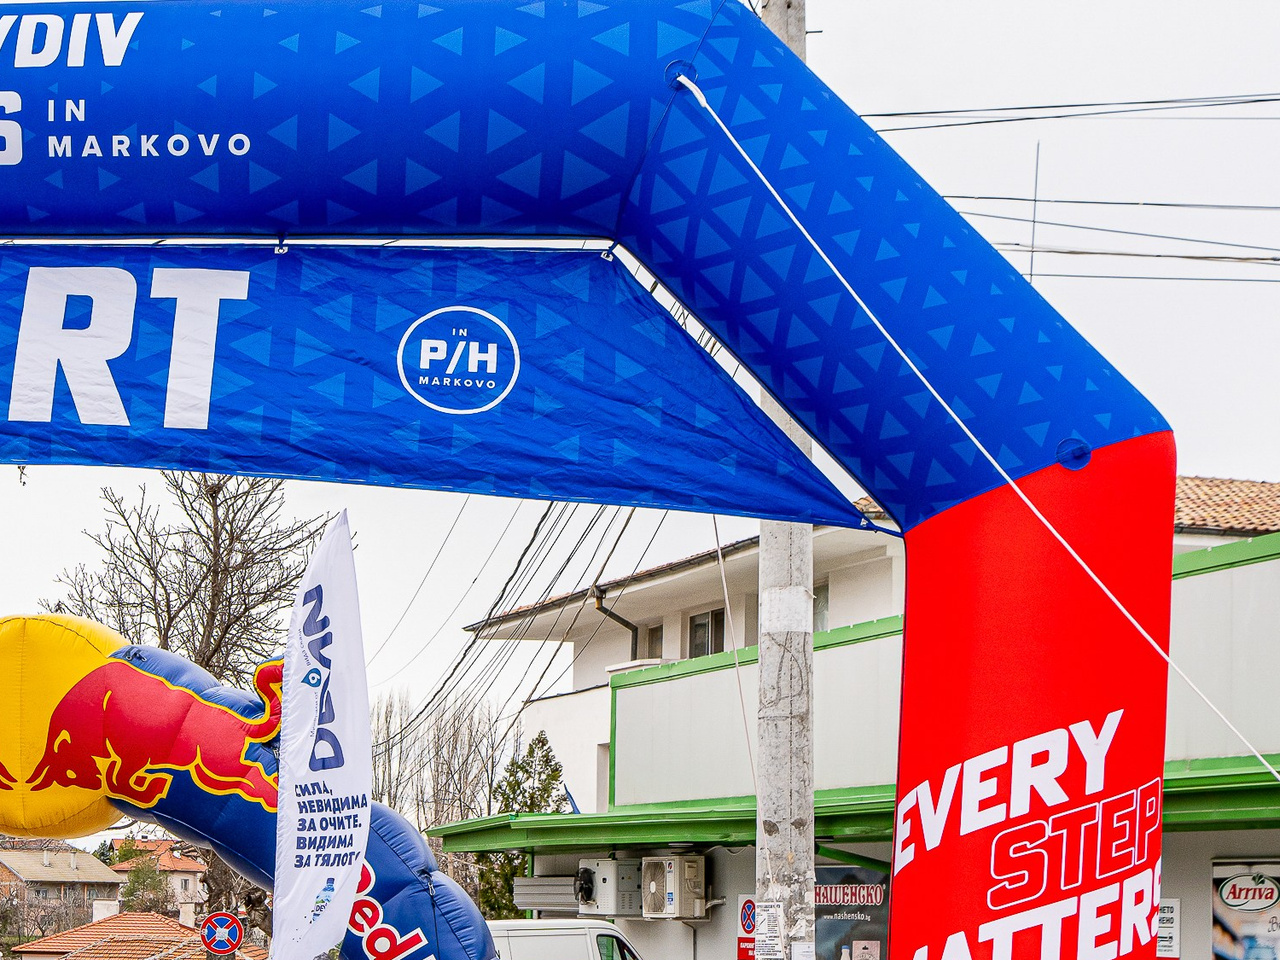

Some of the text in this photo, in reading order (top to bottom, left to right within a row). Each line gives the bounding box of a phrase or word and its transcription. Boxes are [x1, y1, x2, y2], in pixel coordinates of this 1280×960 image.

[47, 99, 85, 122] IN
[47, 134, 252, 157] MARKOVO
[452, 328, 468, 337] IN
[419, 339, 498, 374] P/H
[418, 376, 496, 389] MARKOVO
[894, 708, 1125, 877] EVERY
[297, 794, 368, 814] НЕВИДИМА
[297, 814, 362, 831] ЗА ОЧИТЕ.
[296, 834, 353, 851] ВИДИМА
[987, 777, 1161, 910] STEP
[294, 854, 311, 868] ЗА
[1225, 883, 1275, 900] Arriva
